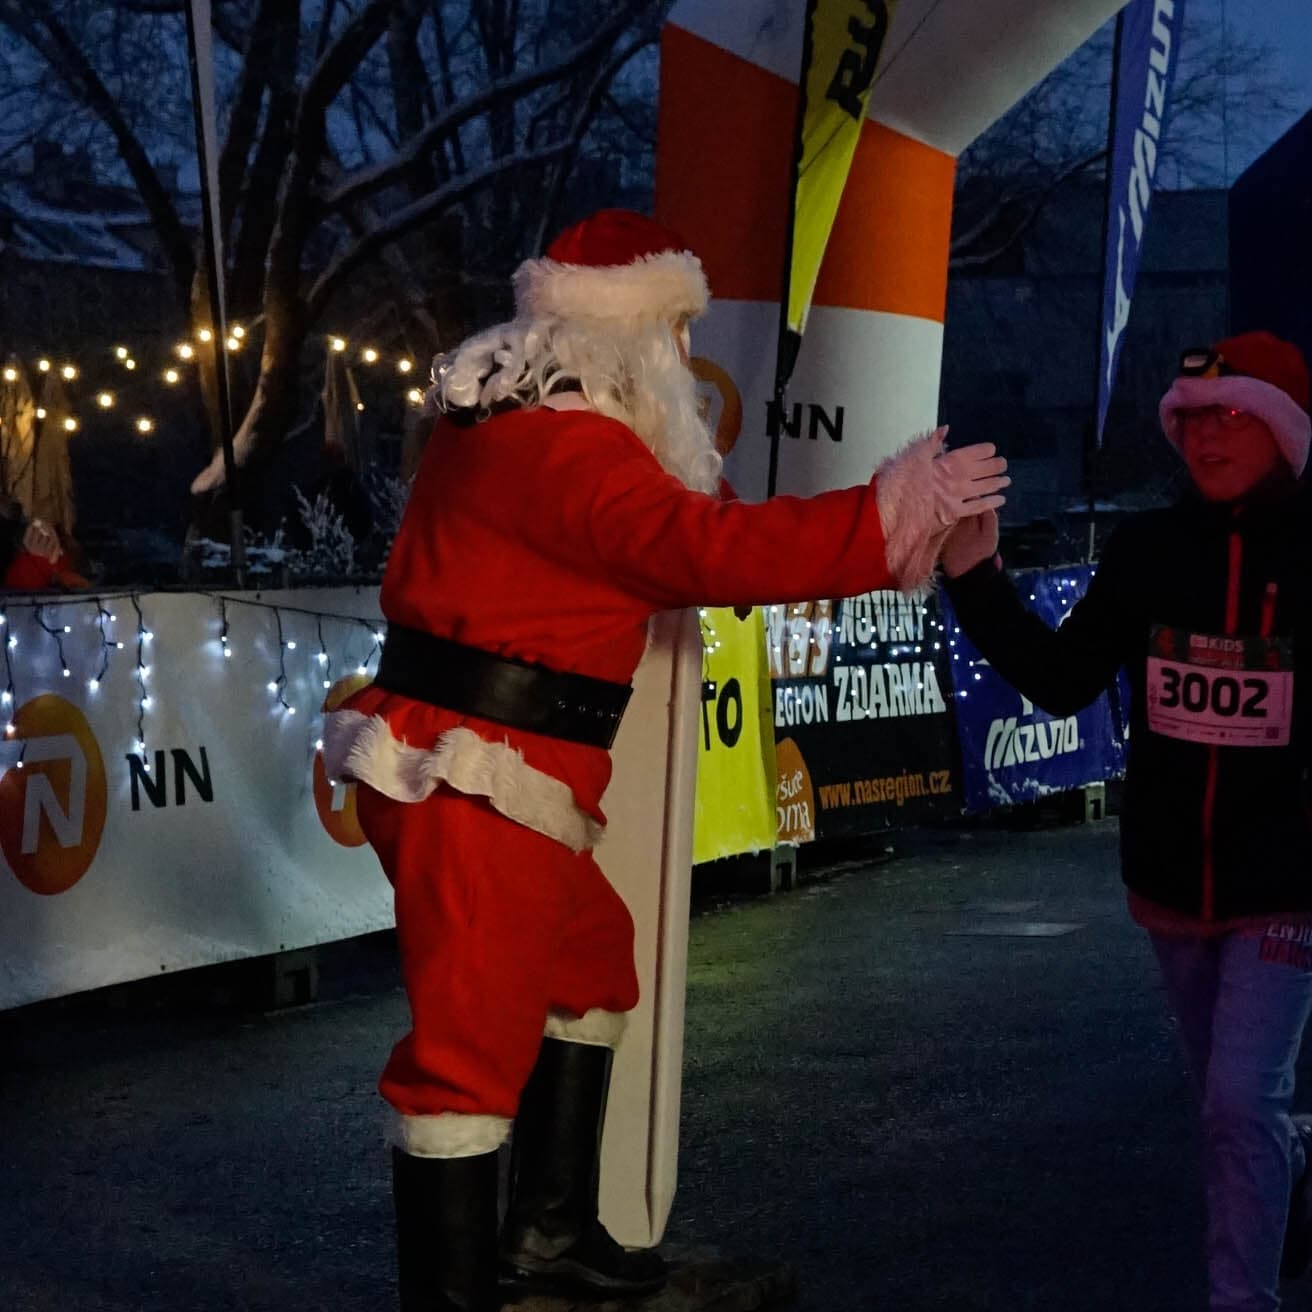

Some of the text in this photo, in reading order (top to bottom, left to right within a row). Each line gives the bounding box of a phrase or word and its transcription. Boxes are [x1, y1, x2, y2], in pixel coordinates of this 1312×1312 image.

[767, 401, 844, 442] NN
[775, 661, 946, 727] EGION ZDARMA
[1160, 667, 1268, 717] 3002
[125, 746, 213, 810] NN
